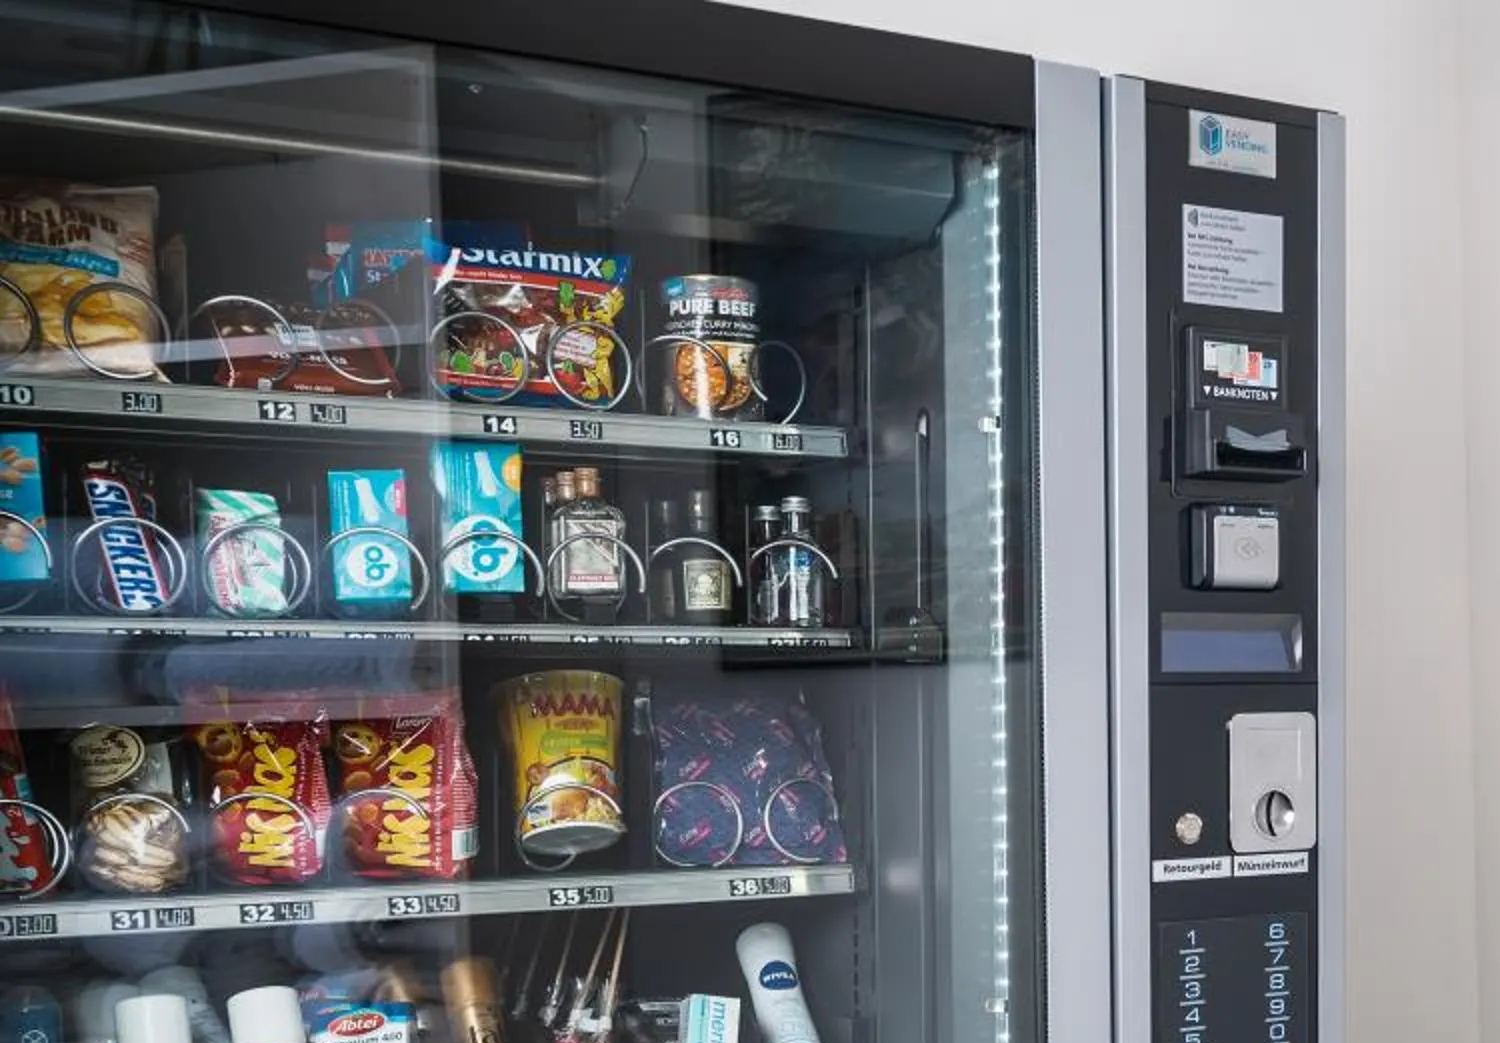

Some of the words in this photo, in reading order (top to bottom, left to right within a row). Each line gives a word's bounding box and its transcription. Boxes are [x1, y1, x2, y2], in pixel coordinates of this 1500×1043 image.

[669, 299, 714, 316] PURE
[719, 300, 757, 317] BEEF
[0, 387, 32, 405] 10
[1213, 386, 1269, 400] BANKNOTEN
[262, 401, 295, 419] 12
[487, 417, 516, 433] 14
[713, 430, 740, 446] 16
[532, 692, 614, 720] MAMA
[1163, 860, 1223, 875] Retourgeld
[1237, 858, 1305, 873] Münzeinwurf
[551, 889, 579, 905] 35
[733, 881, 757, 896] 36
[243, 905, 275, 922] 32
[391, 897, 421, 914] 33
[114, 911, 145, 929] 31
[336, 1015, 379, 1034] Abtei
